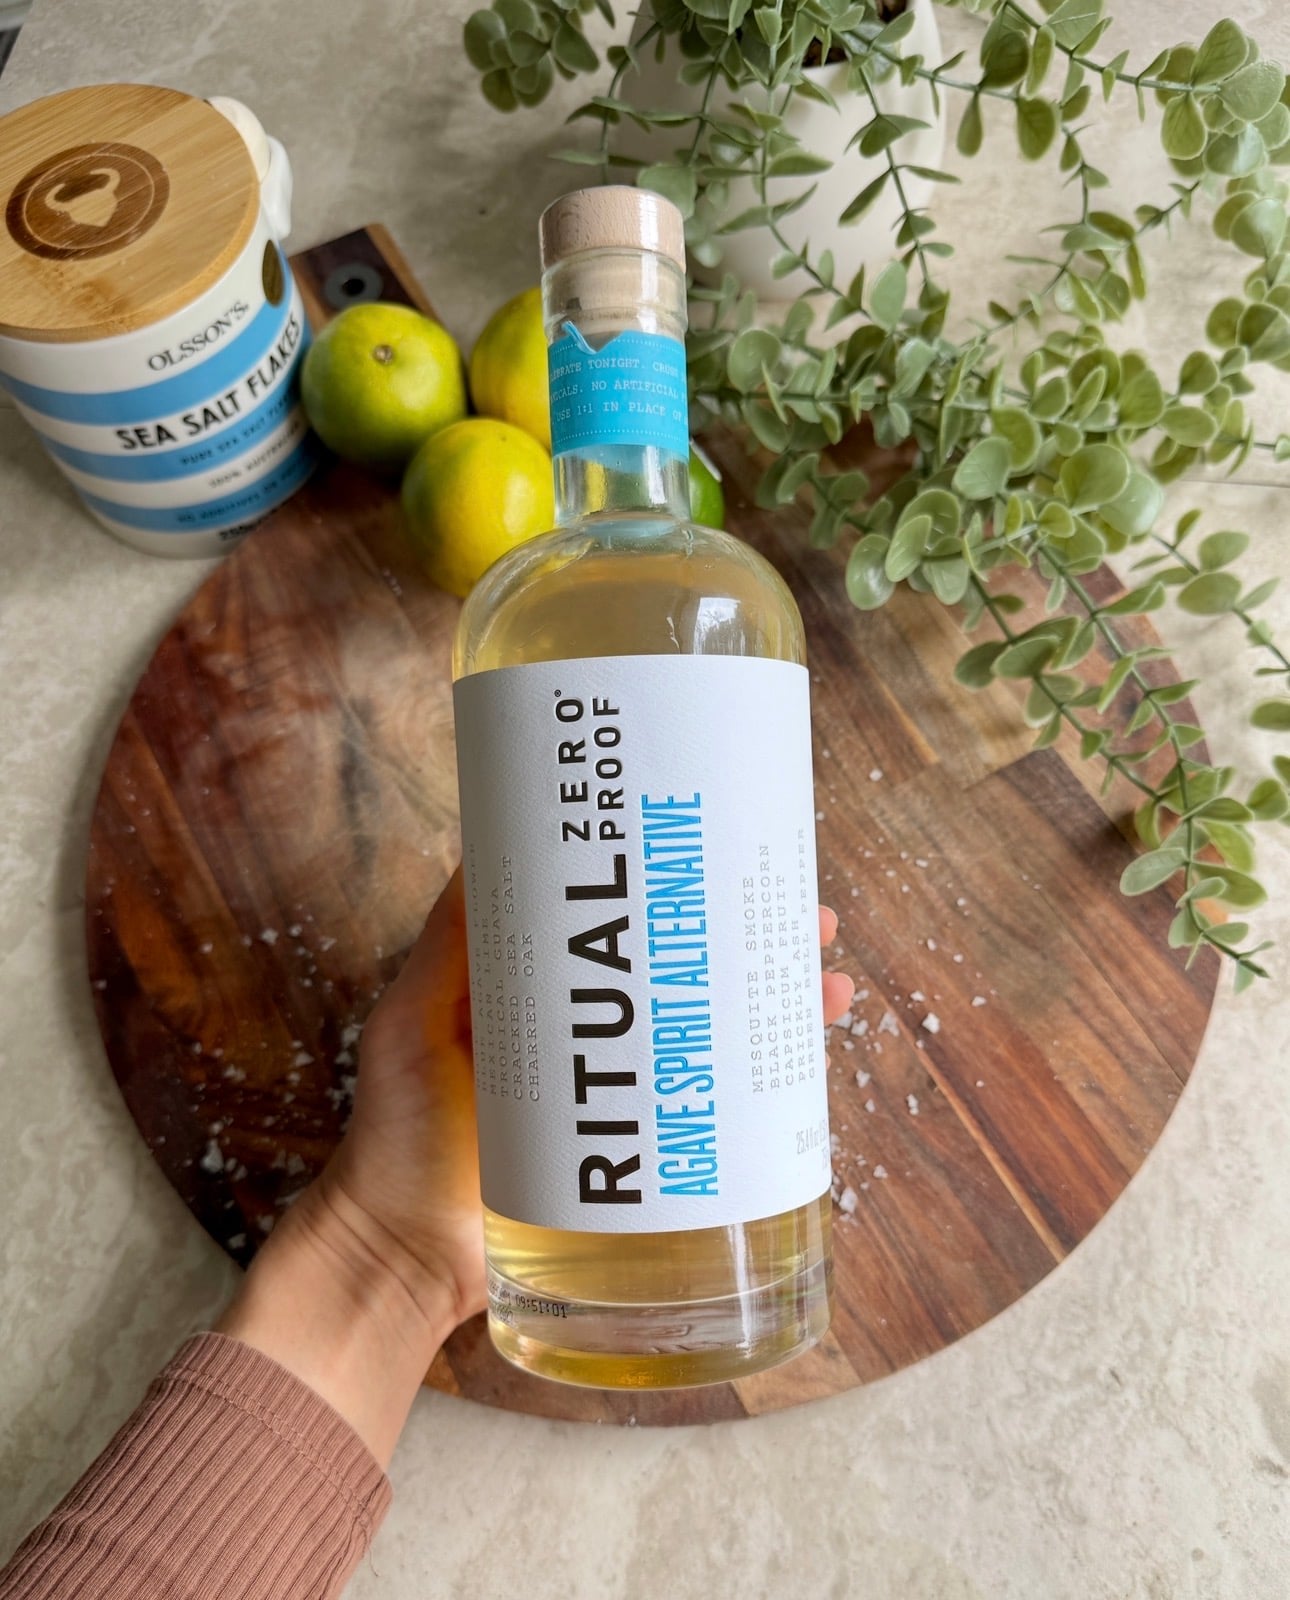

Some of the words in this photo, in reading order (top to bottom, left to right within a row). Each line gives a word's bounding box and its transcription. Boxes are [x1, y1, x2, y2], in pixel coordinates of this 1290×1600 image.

[116, 424, 177, 450] SEA
[182, 390, 242, 437] SALT
[246, 313, 300, 398] FLAKES
[577, 404, 593, 416] 1:1
[603, 401, 619, 412] IN
[629, 402, 666, 417] PLACE
[592, 381, 607, 391] NO
[614, 380, 679, 399] ARTIFICIAL
[592, 696, 626, 840] PROOF
[491, 887, 502, 961] GUAVA
[502, 855, 514, 914] SALT
[640, 792, 709, 987] ALTERNATIVE
[742, 876, 757, 951] SMOKE
[759, 845, 776, 997] PEPPERCORN
[776, 875, 788, 948] FRUIT
[482, 918, 491, 974] LIME
[506, 933, 517, 976] SEA
[522, 933, 534, 977] OAK
[791, 919, 801, 962] ASH
[486, 994, 497, 1095] MEXICAN
[496, 979, 508, 1097] TROPICAL
[509, 995, 523, 1100] CRACKED
[525, 996, 540, 1102] CHARRED
[565, 853, 642, 1204] RITUAL
[651, 997, 714, 1094] SPIRIT
[747, 971, 763, 1093] MESQUITE
[767, 1015, 781, 1090] BLACK
[780, 966, 794, 1087] CAPSICUM
[795, 981, 806, 1083] PRICKLY
[655, 1100, 719, 1196] AGAVE
[515, 1294, 568, 1319] 09:51:01
